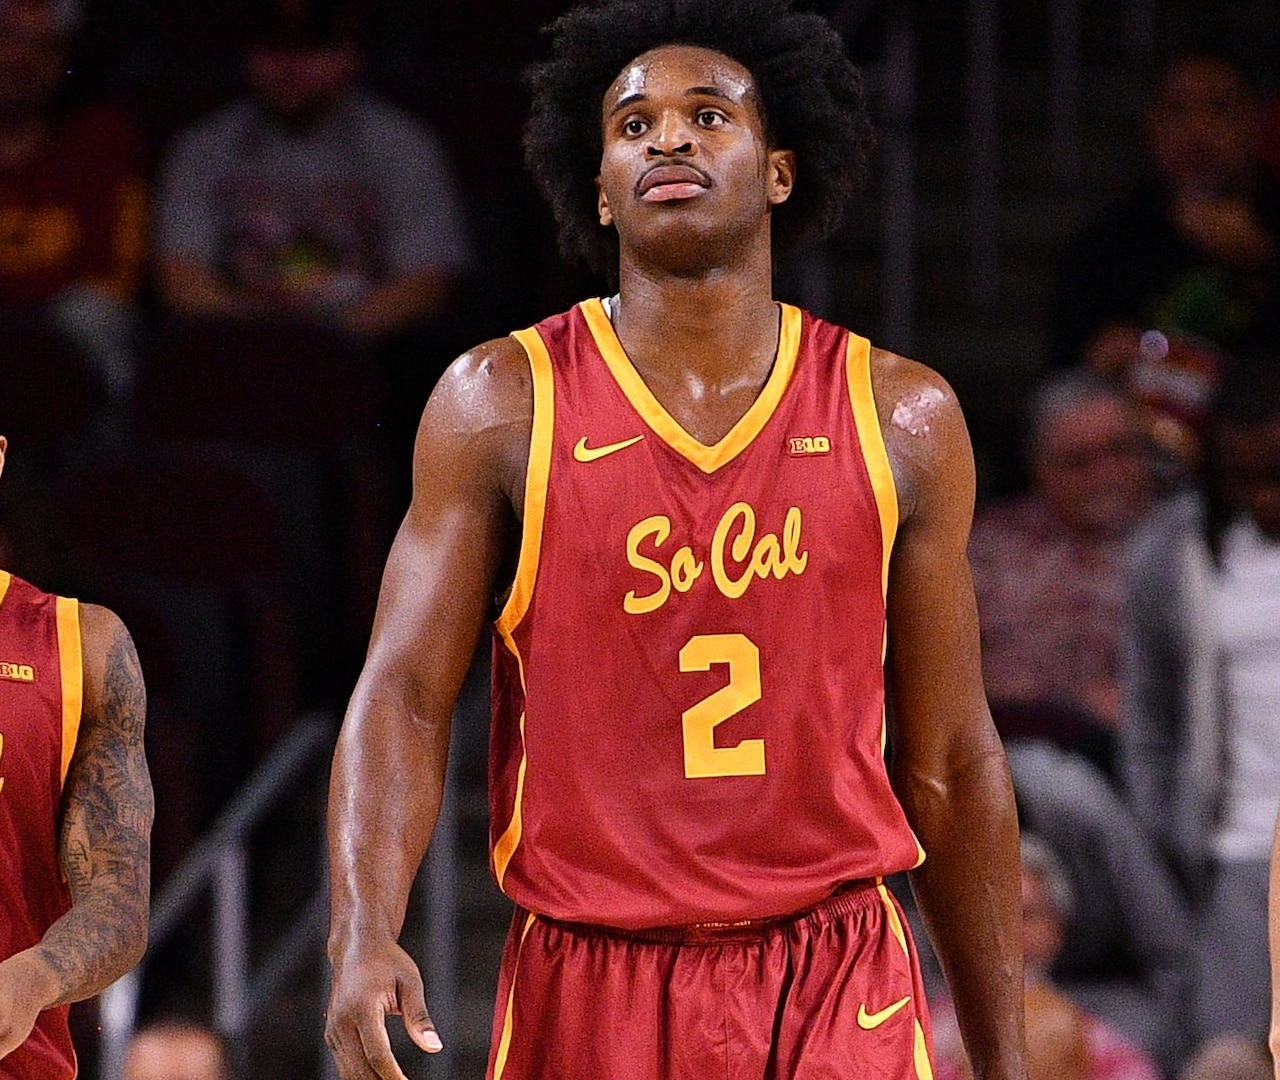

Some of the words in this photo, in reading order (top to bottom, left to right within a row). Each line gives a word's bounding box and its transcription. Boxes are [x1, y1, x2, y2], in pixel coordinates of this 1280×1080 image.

[624, 515, 704, 614] So
[711, 502, 808, 599] Cal
[679, 633, 766, 778] 2
